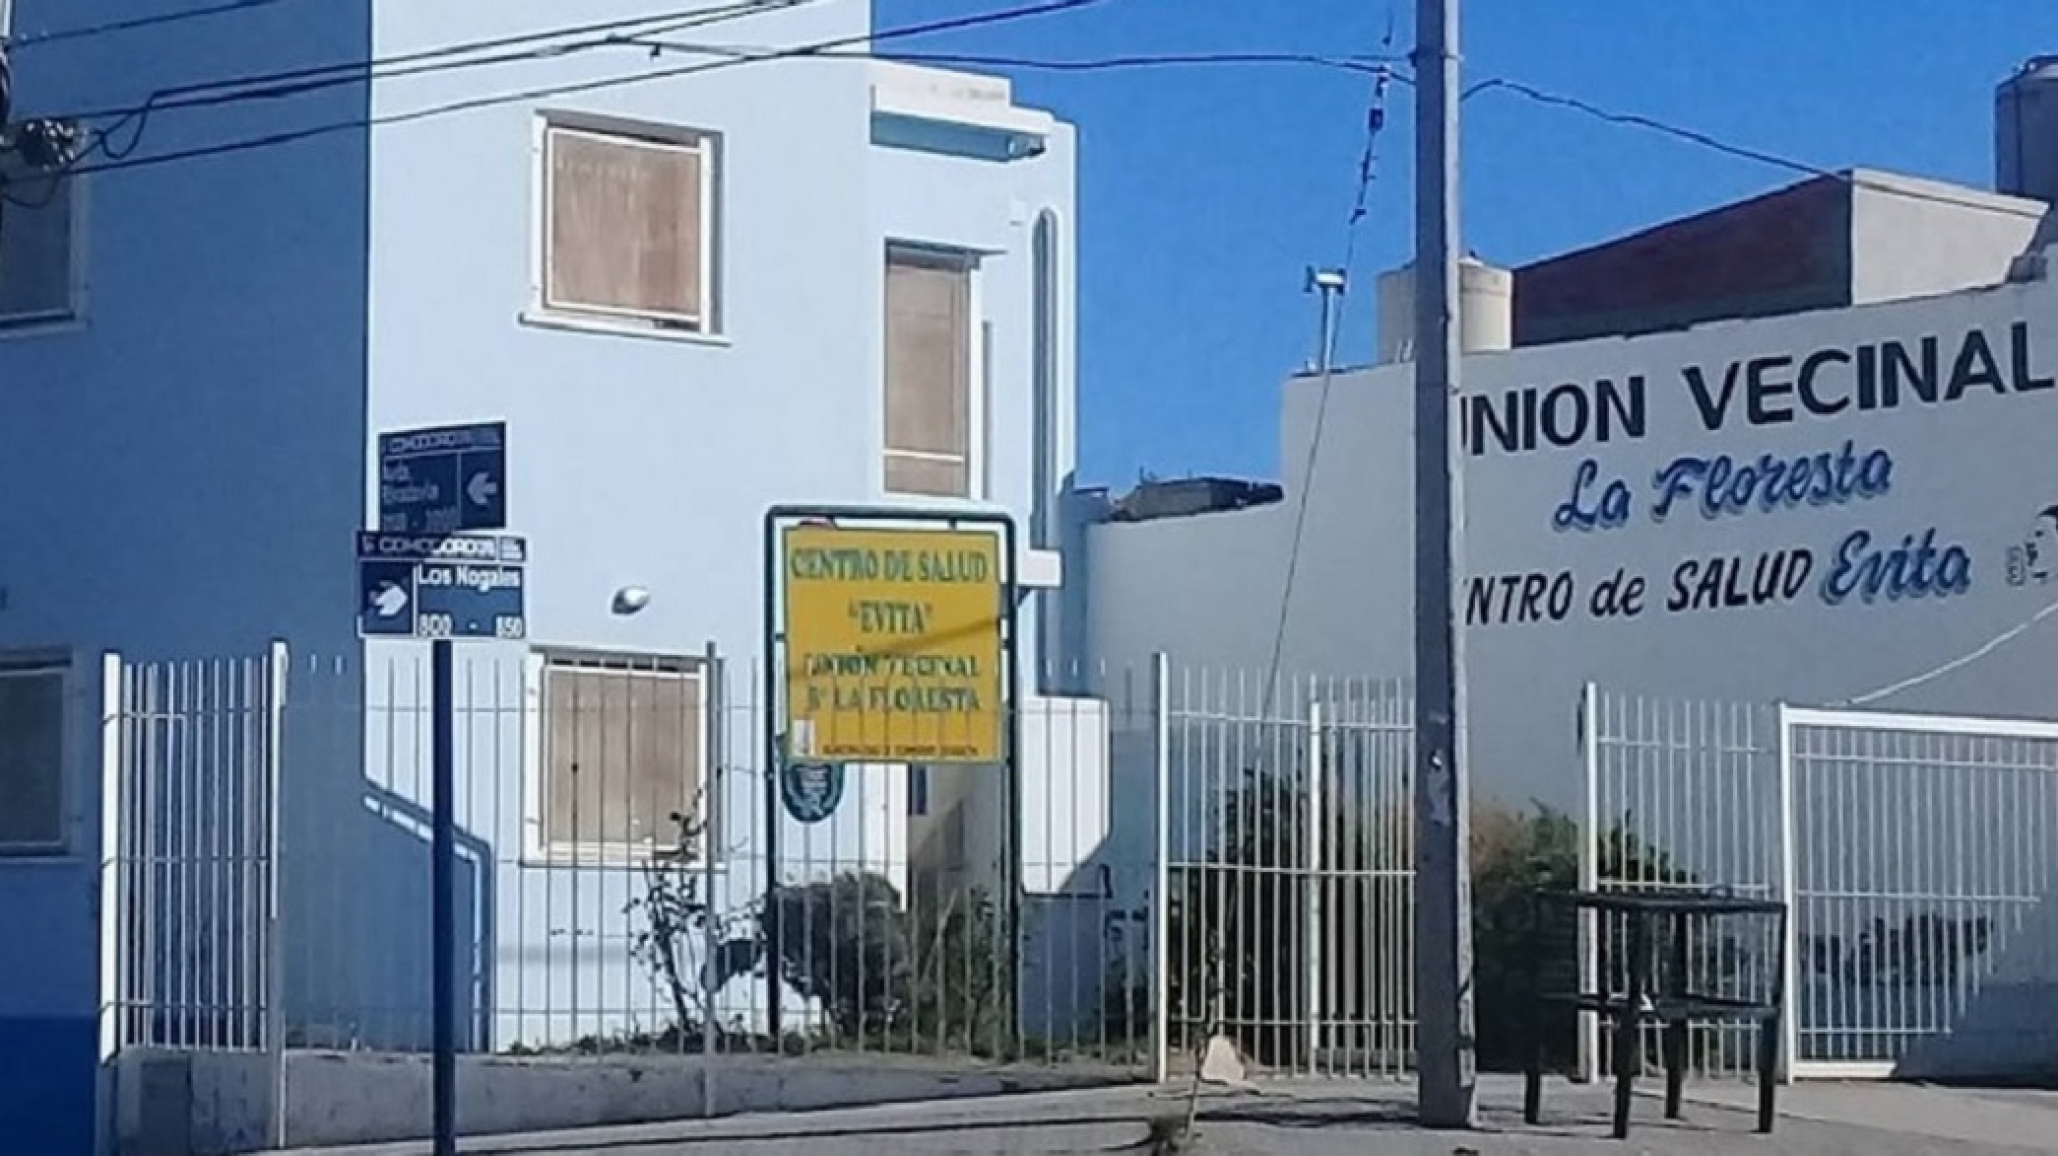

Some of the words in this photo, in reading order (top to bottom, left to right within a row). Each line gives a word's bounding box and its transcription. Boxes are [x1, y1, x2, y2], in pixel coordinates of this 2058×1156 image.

[1682, 321, 2055, 430] VECINAL
[1553, 458, 1631, 531] La
[1652, 440, 1892, 523] Floresta
[418, 563, 452, 585] Los
[456, 564, 521, 593] Nogales
[790, 548, 879, 580] CENTRO
[882, 549, 914, 582] DE
[918, 549, 988, 582] SALUD
[1463, 571, 1574, 625] NTRO
[1590, 568, 1646, 616] de
[1667, 549, 1813, 612] SALUD
[1823, 527, 1971, 605] Evita
